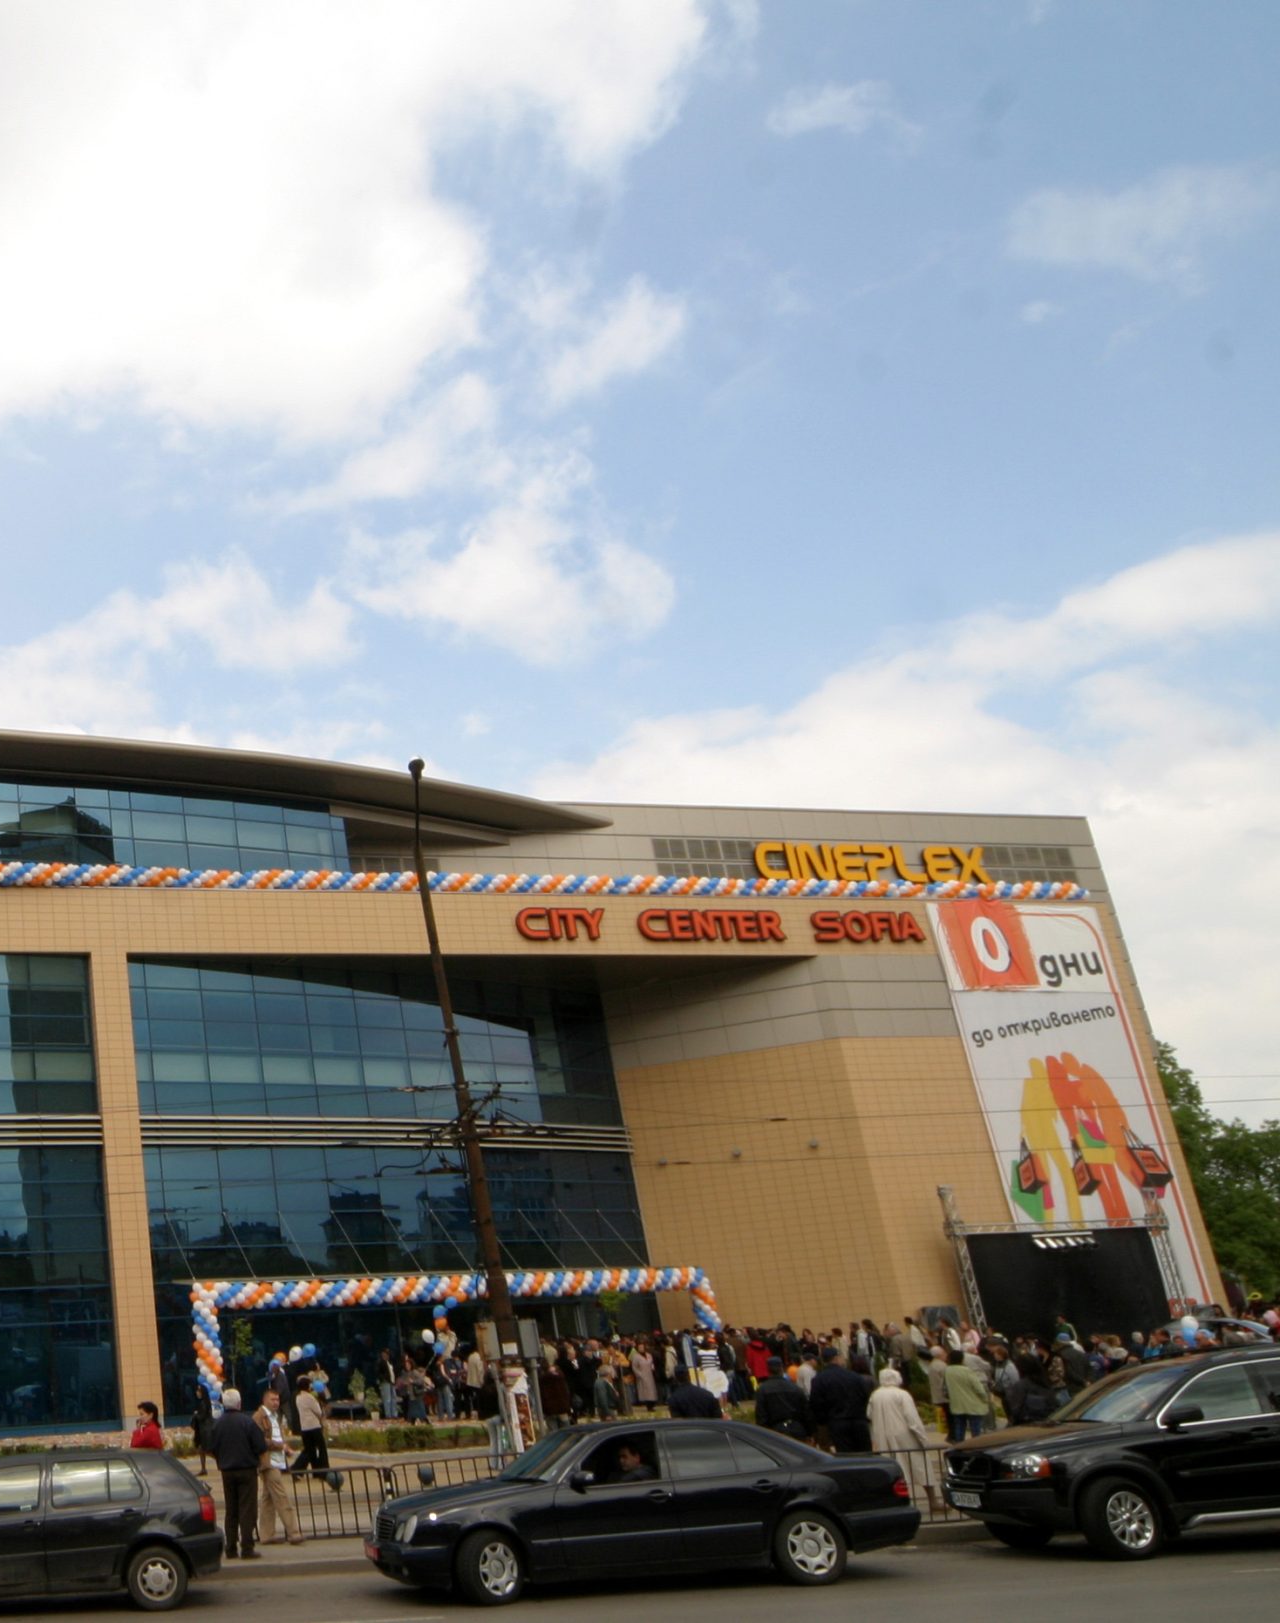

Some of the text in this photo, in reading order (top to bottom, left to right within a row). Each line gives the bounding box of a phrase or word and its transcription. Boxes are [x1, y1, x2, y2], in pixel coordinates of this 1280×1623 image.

[754, 841, 993, 885] CINEPLEX
[516, 907, 926, 943] CITY CENTER SOFIA
[1040, 950, 1104, 988] дни
[971, 1004, 1116, 1048] до откриването
